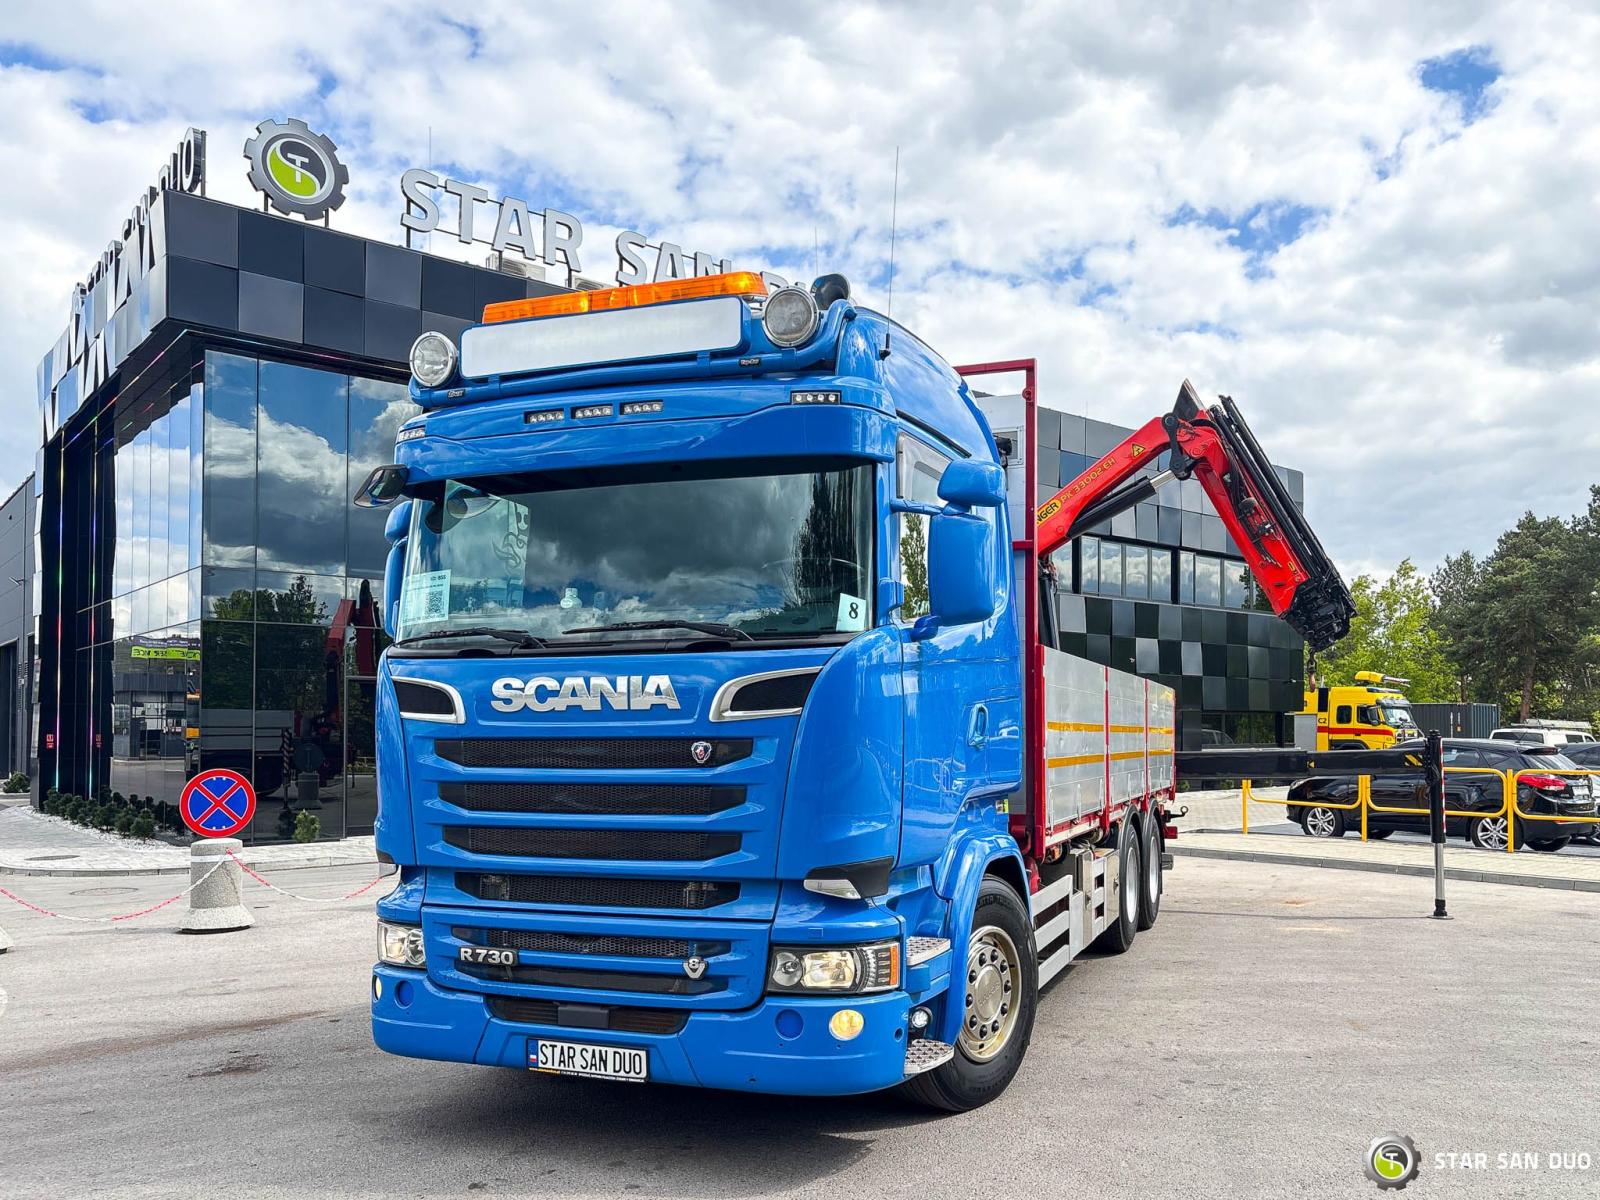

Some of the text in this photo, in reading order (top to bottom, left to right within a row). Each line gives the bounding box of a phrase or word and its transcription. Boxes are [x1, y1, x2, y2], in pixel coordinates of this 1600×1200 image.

[400, 168, 732, 286] STAR SAN
[1073, 466, 1104, 493] 33002
[849, 602, 859, 619] 8
[490, 674, 682, 713] SCANIA
[460, 947, 514, 965] R 730
[539, 1043, 642, 1076] STAR SAN DUO
